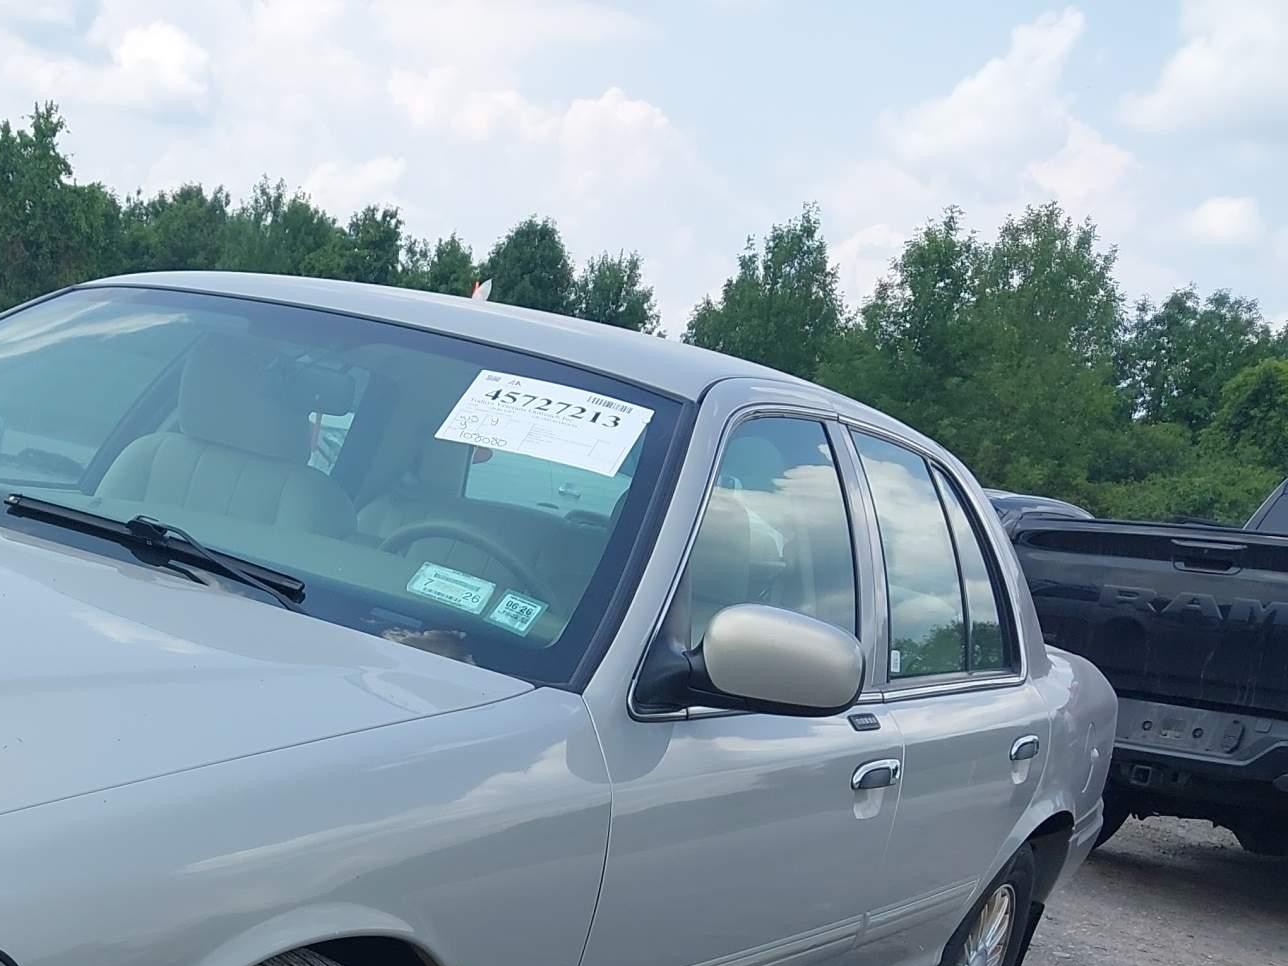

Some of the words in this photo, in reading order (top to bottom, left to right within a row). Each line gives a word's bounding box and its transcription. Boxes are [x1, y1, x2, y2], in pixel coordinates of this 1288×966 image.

[484, 388, 621, 428] 45727213
[424, 577, 435, 586] 7
[462, 591, 481, 604] 26
[1099, 584, 1288, 625] RAM
